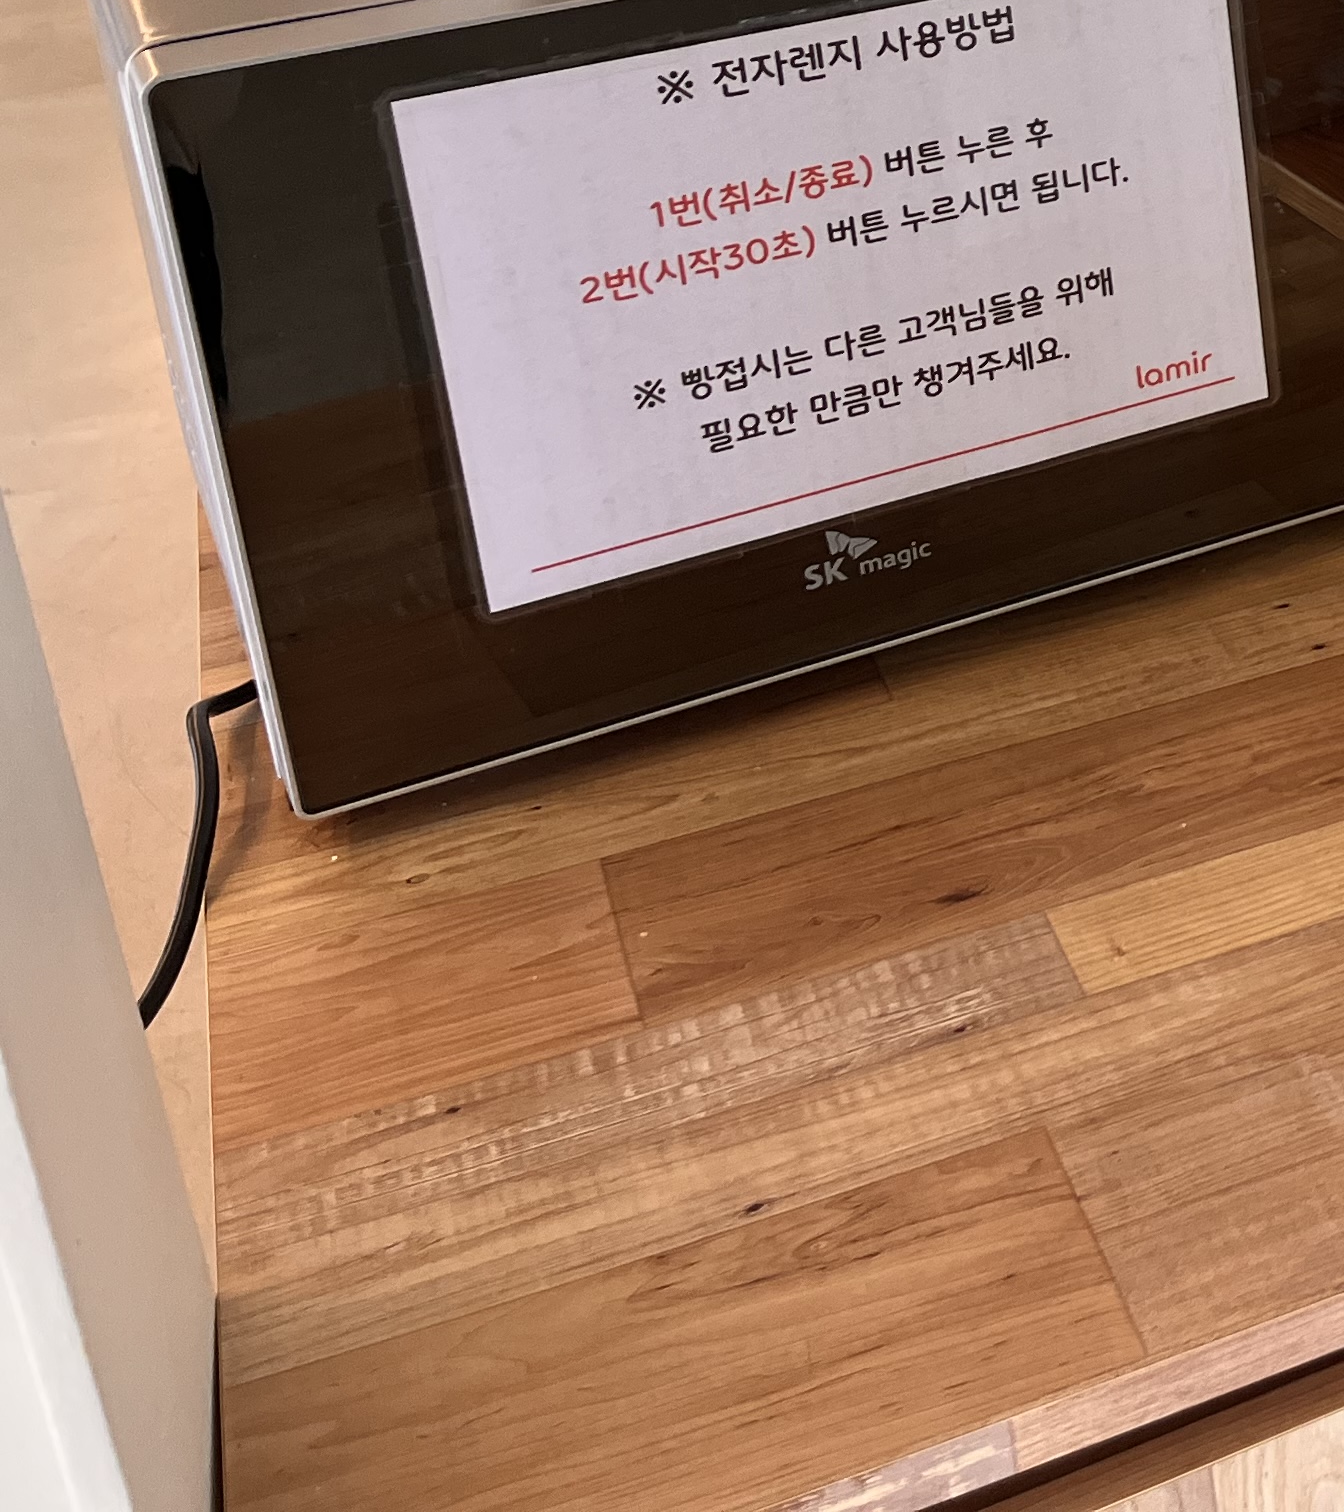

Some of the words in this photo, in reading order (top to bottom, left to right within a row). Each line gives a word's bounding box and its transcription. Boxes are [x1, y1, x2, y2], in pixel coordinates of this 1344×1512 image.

[711, 35, 862, 98] 전자렌지
[876, 5, 1015, 61] 사용방법
[650, 155, 873, 228] 1번(취소/종료)
[884, 139, 946, 177] 버튼
[957, 125, 1014, 164] 누른
[1025, 118, 1053, 149] 후
[579, 225, 816, 304] 2번(시작30초)
[827, 209, 889, 247] 버튼
[901, 179, 1020, 233] 누르시면
[1031, 157, 1129, 204] 됩니다.
[681, 345, 812, 400] 빵접시는
[824, 324, 886, 361] 다른
[898, 285, 1045, 344] 고객님들을
[1055, 266, 1115, 306] 위해
[1135, 349, 1213, 389] lamir
[700, 401, 798, 453] 필요한
[809, 375, 903, 425] 만큼만
[914, 336, 1072, 398] 챙겨주세요.
[804, 555, 849, 591] SK
[859, 539, 932, 576] magic
